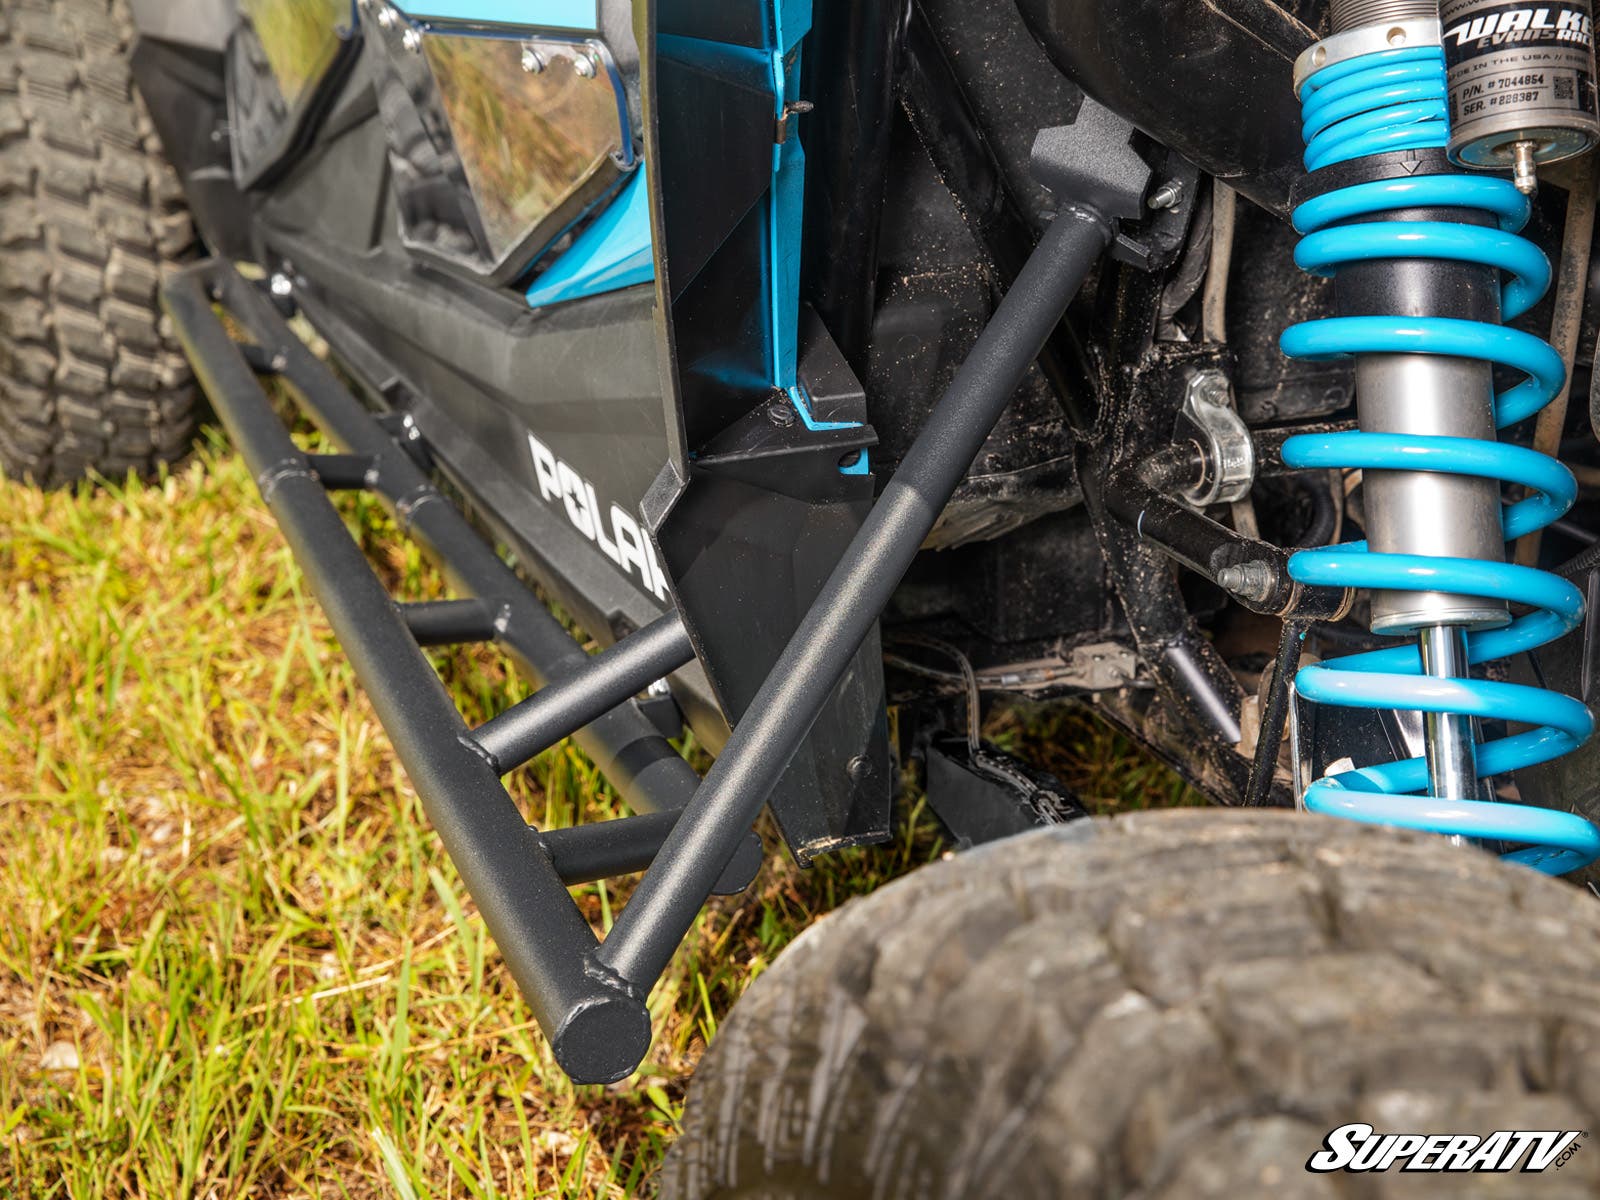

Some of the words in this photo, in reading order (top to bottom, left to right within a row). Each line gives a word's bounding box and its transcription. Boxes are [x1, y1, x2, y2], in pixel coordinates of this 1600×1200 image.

[1473, 62, 1487, 71] IN
[1491, 56, 1518, 65] THE
[1462, 83, 1484, 99] P/N.
[1463, 101, 1486, 116] SER.
